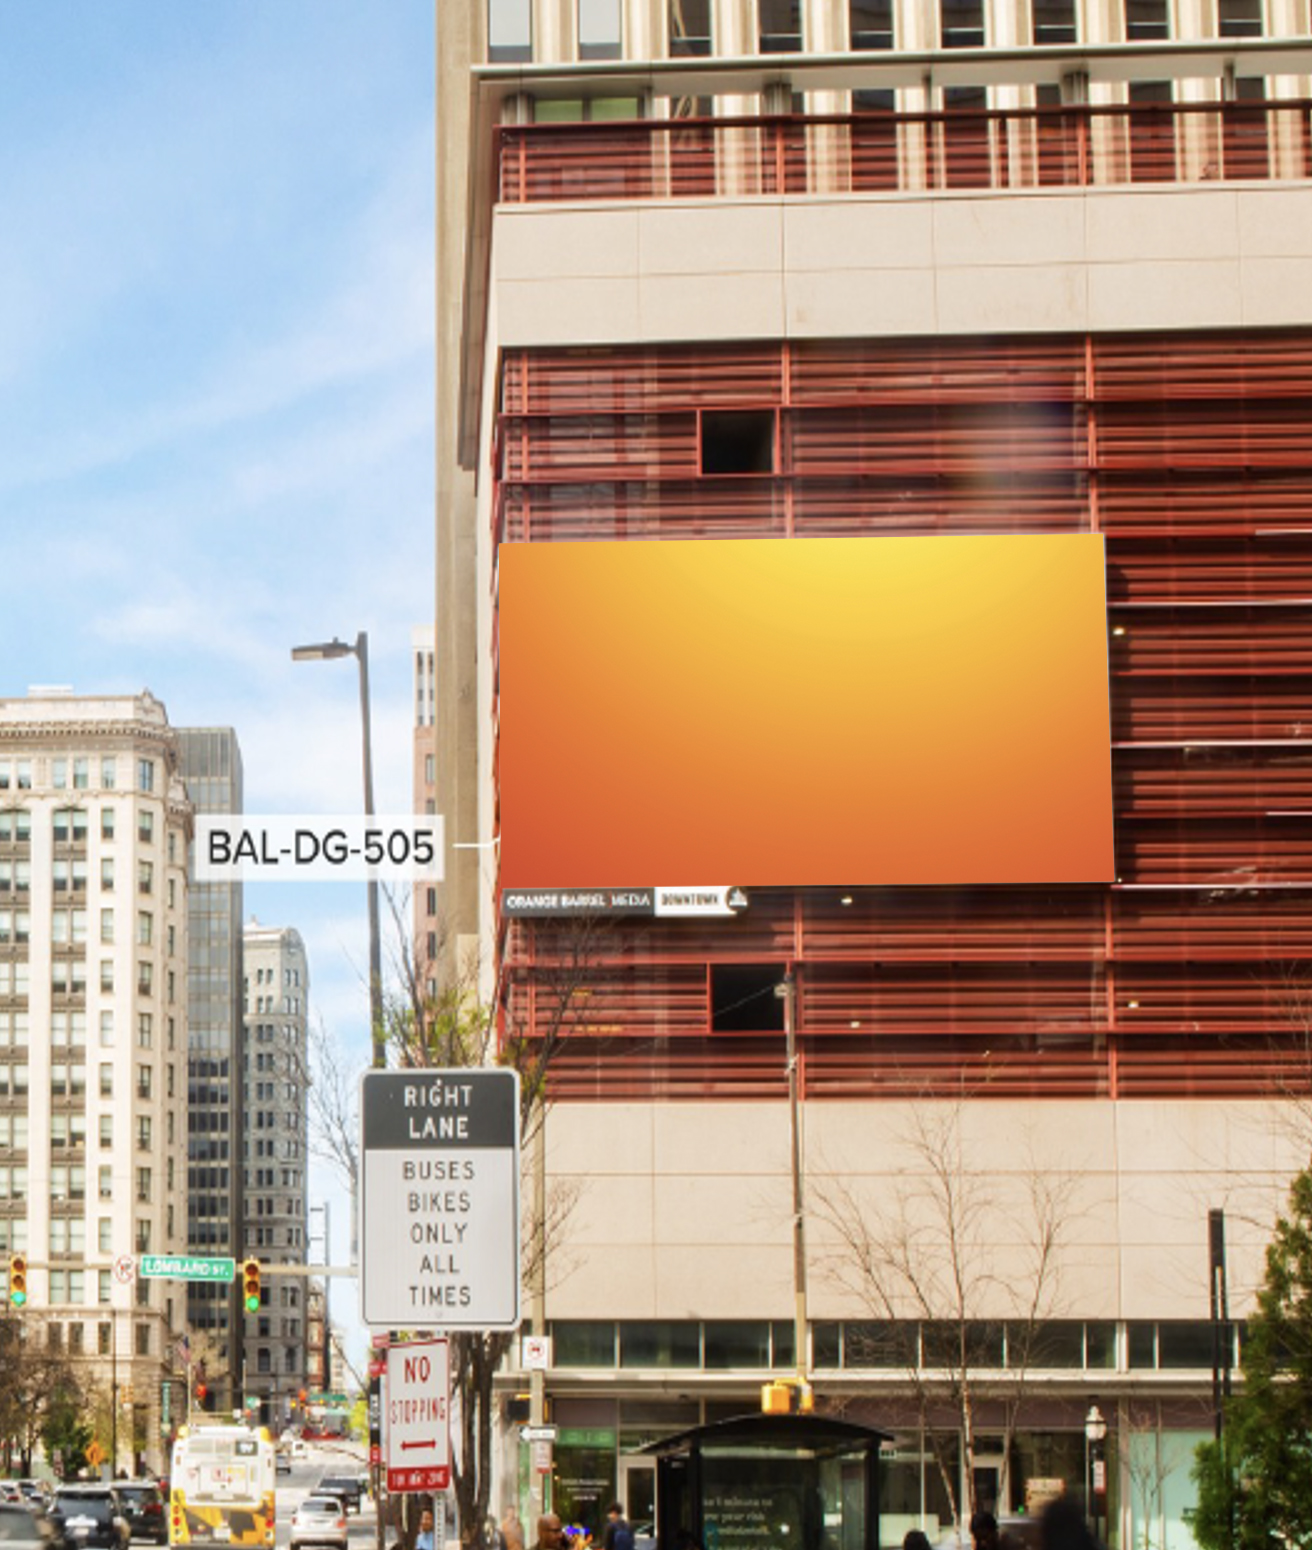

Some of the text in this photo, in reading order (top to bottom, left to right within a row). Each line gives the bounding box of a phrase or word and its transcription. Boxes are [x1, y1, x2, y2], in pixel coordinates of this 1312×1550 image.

[507, 892, 650, 909] ORANGE BARREL MEDIA
[404, 1085, 473, 1107] RIGHT
[409, 1116, 469, 1139] LANE
[402, 1160, 475, 1181] BUSES
[407, 1191, 471, 1212] BIKES
[410, 1222, 468, 1244] ONLY
[145, 1260, 210, 1276] LOMBARD
[419, 1254, 460, 1274] ALL
[409, 1285, 471, 1307] TIMES
[404, 1356, 431, 1384] NO
[391, 1397, 446, 1425] STOPPING
